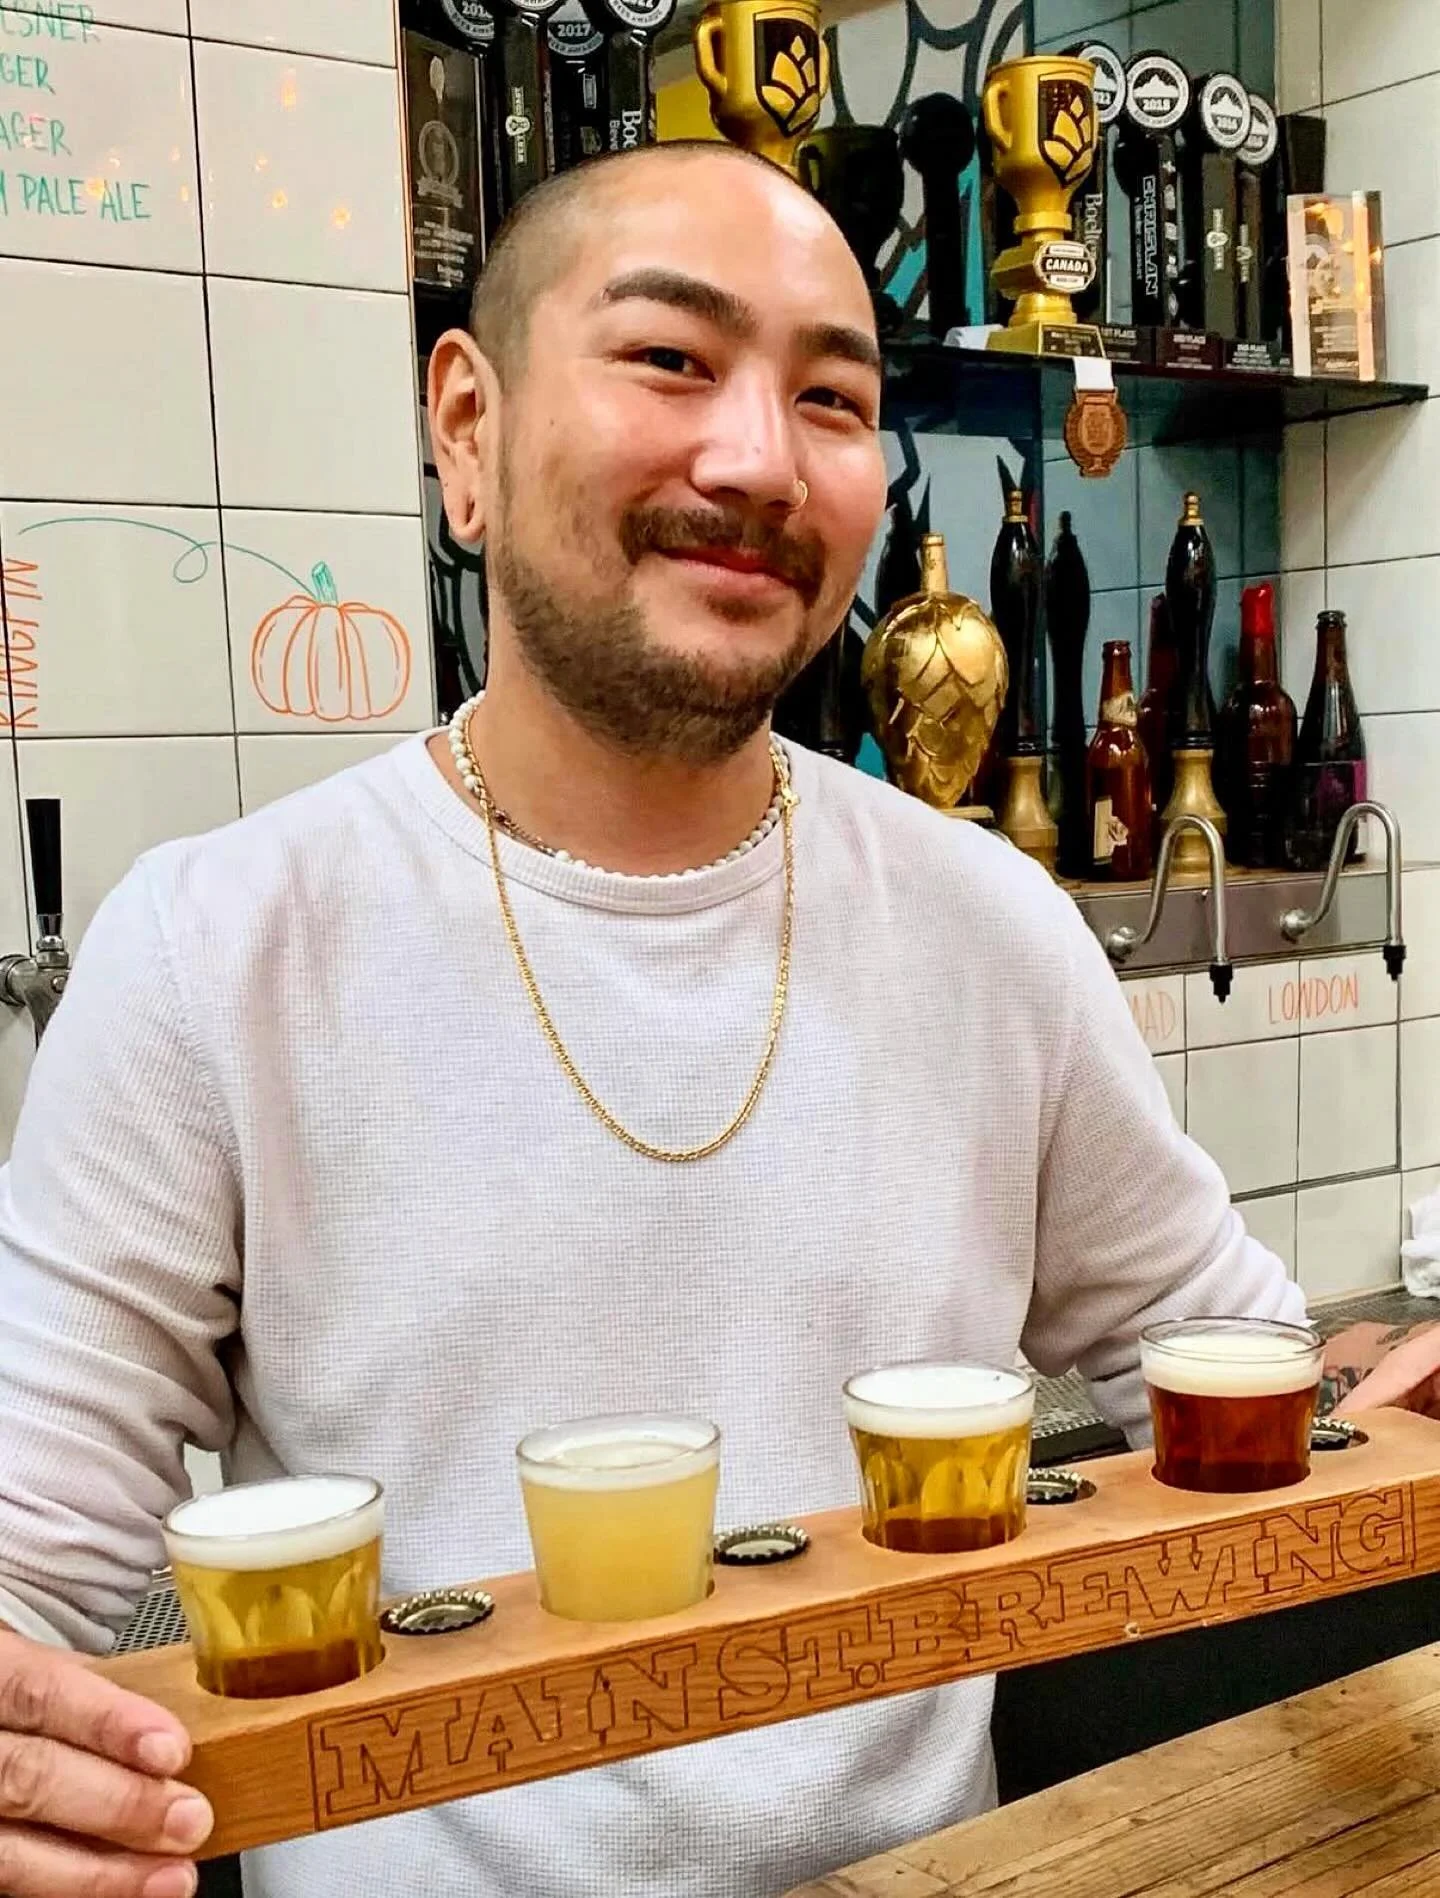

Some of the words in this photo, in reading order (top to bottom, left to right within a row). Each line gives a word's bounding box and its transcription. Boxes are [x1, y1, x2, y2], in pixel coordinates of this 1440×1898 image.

[557, 23, 592, 37] 2017
[16, 173, 87, 215] PALE
[101, 179, 152, 222] ALE
[1046, 258, 1089, 273] CANADA
[1268, 970, 1359, 1025] LONDON
[320, 1642, 697, 1816] MAIN
[879, 1487, 1405, 1662] BREWING
